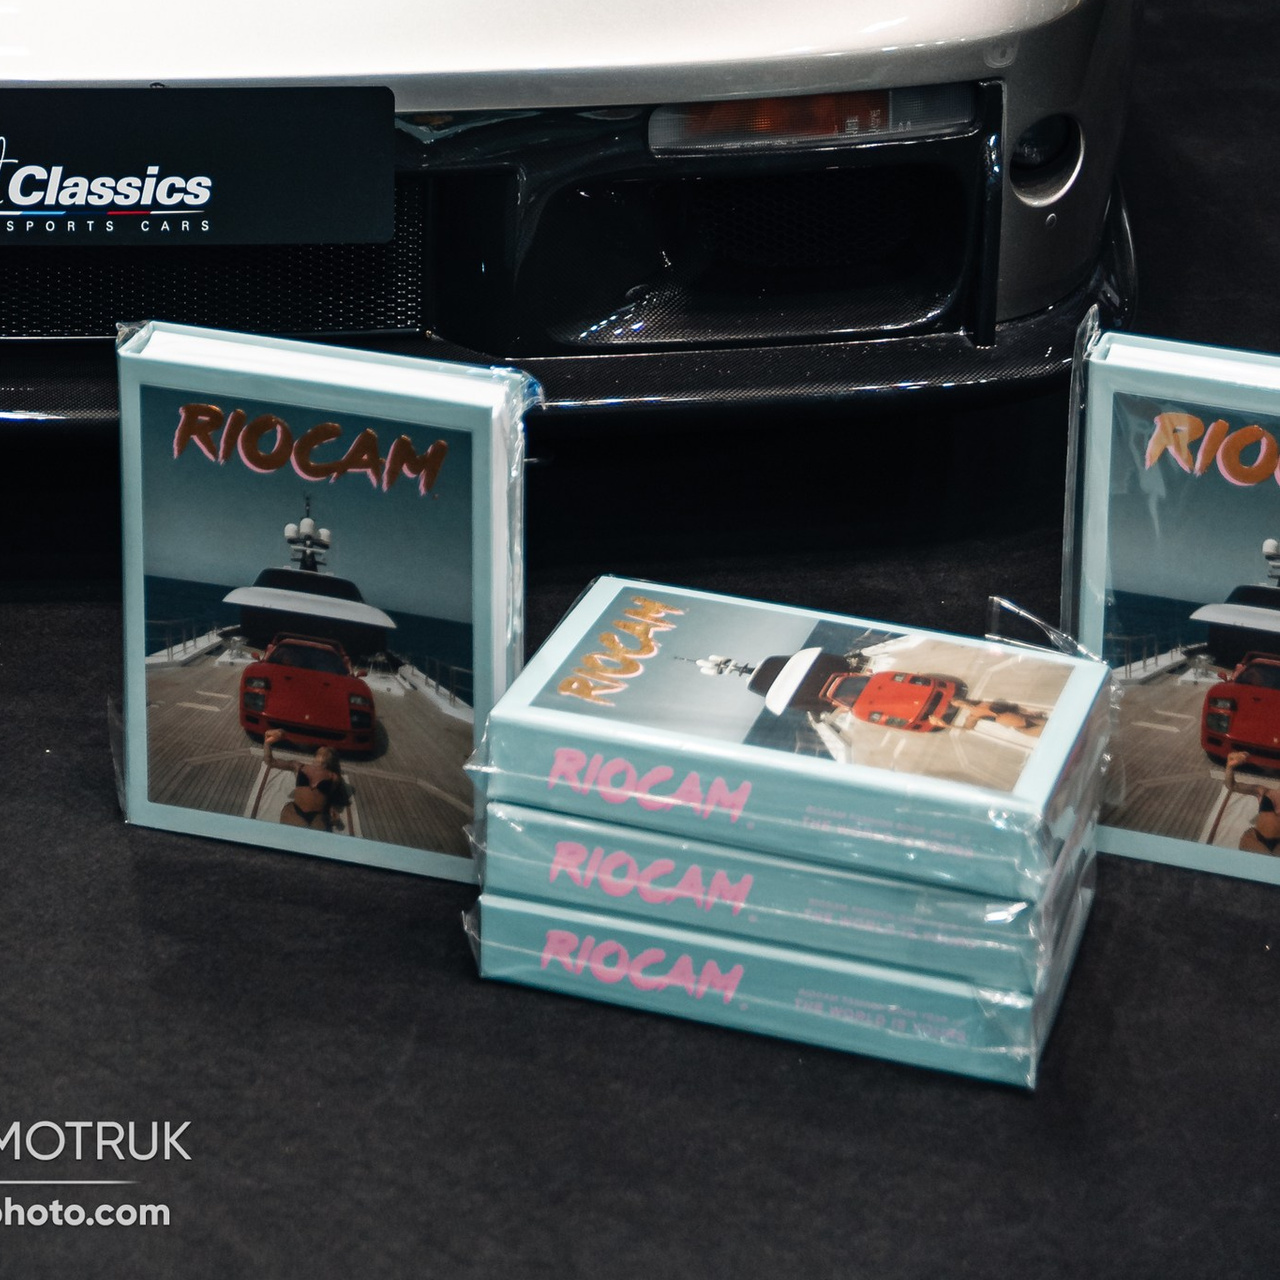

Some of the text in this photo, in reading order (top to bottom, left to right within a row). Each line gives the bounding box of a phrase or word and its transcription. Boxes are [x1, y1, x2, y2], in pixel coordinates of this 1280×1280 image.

[8, 166, 213, 206] Classics
[6, 219, 114, 233] SPORTS
[140, 219, 210, 232] CARS
[173, 403, 449, 497] RIOCAM
[1145, 412, 1280, 487] RIO
[557, 595, 685, 707] RIOCAM
[548, 747, 752, 824] RIOCAM
[549, 841, 754, 916] RIOCAM
[541, 930, 744, 1004] RIOCAM
